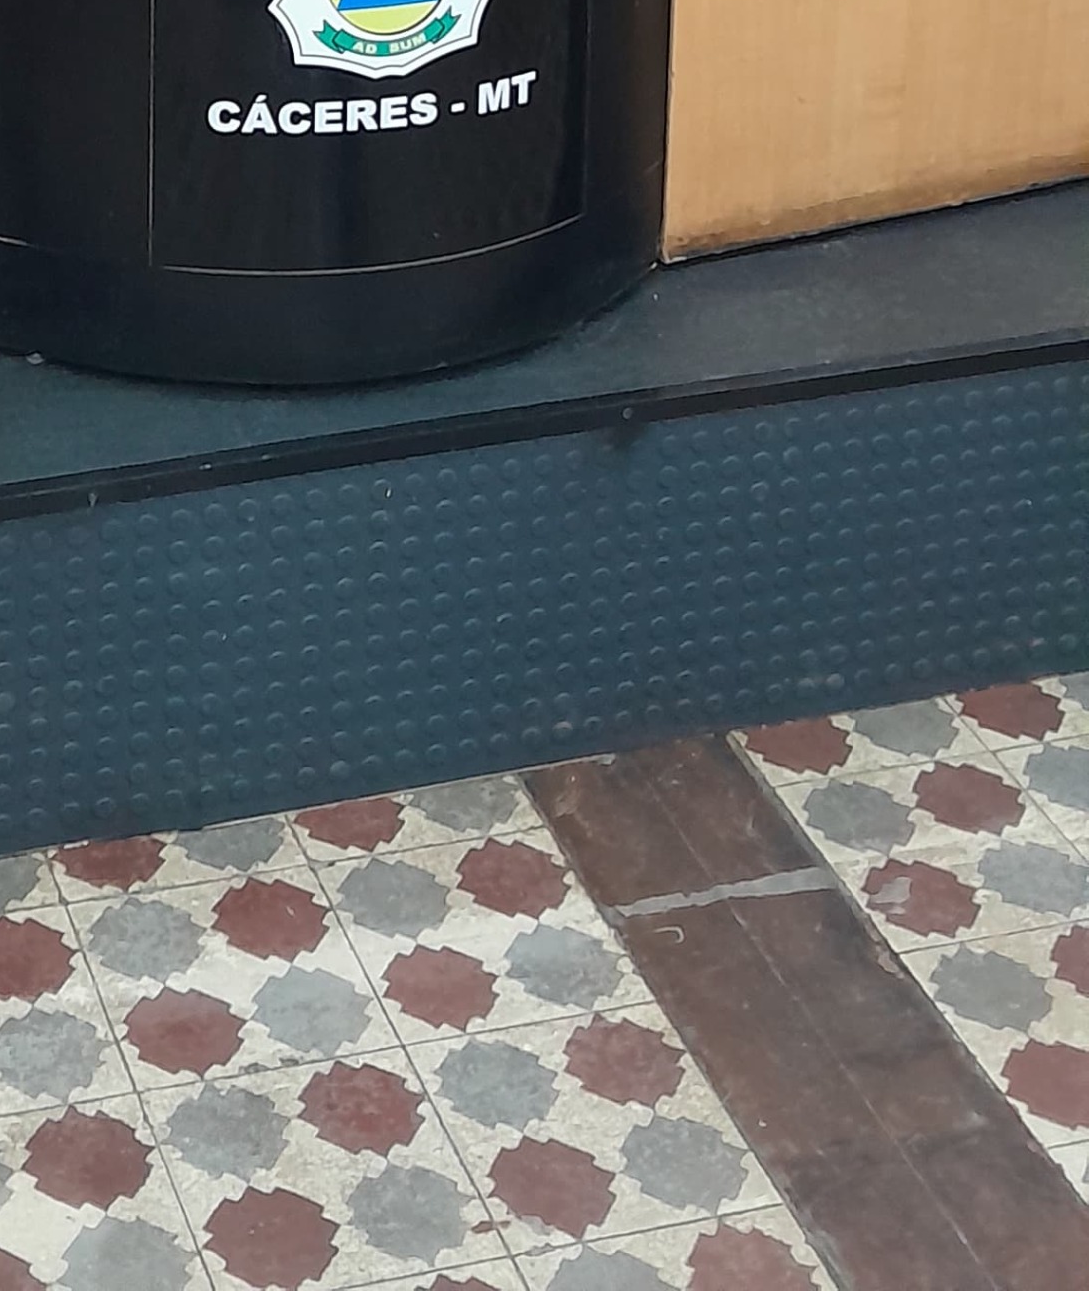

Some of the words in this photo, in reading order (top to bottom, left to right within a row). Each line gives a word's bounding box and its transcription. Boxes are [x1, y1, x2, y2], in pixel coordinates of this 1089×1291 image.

[207, 95, 438, 134] CÁCERES
[451, 102, 465, 113] -
[477, 71, 537, 115] MT
